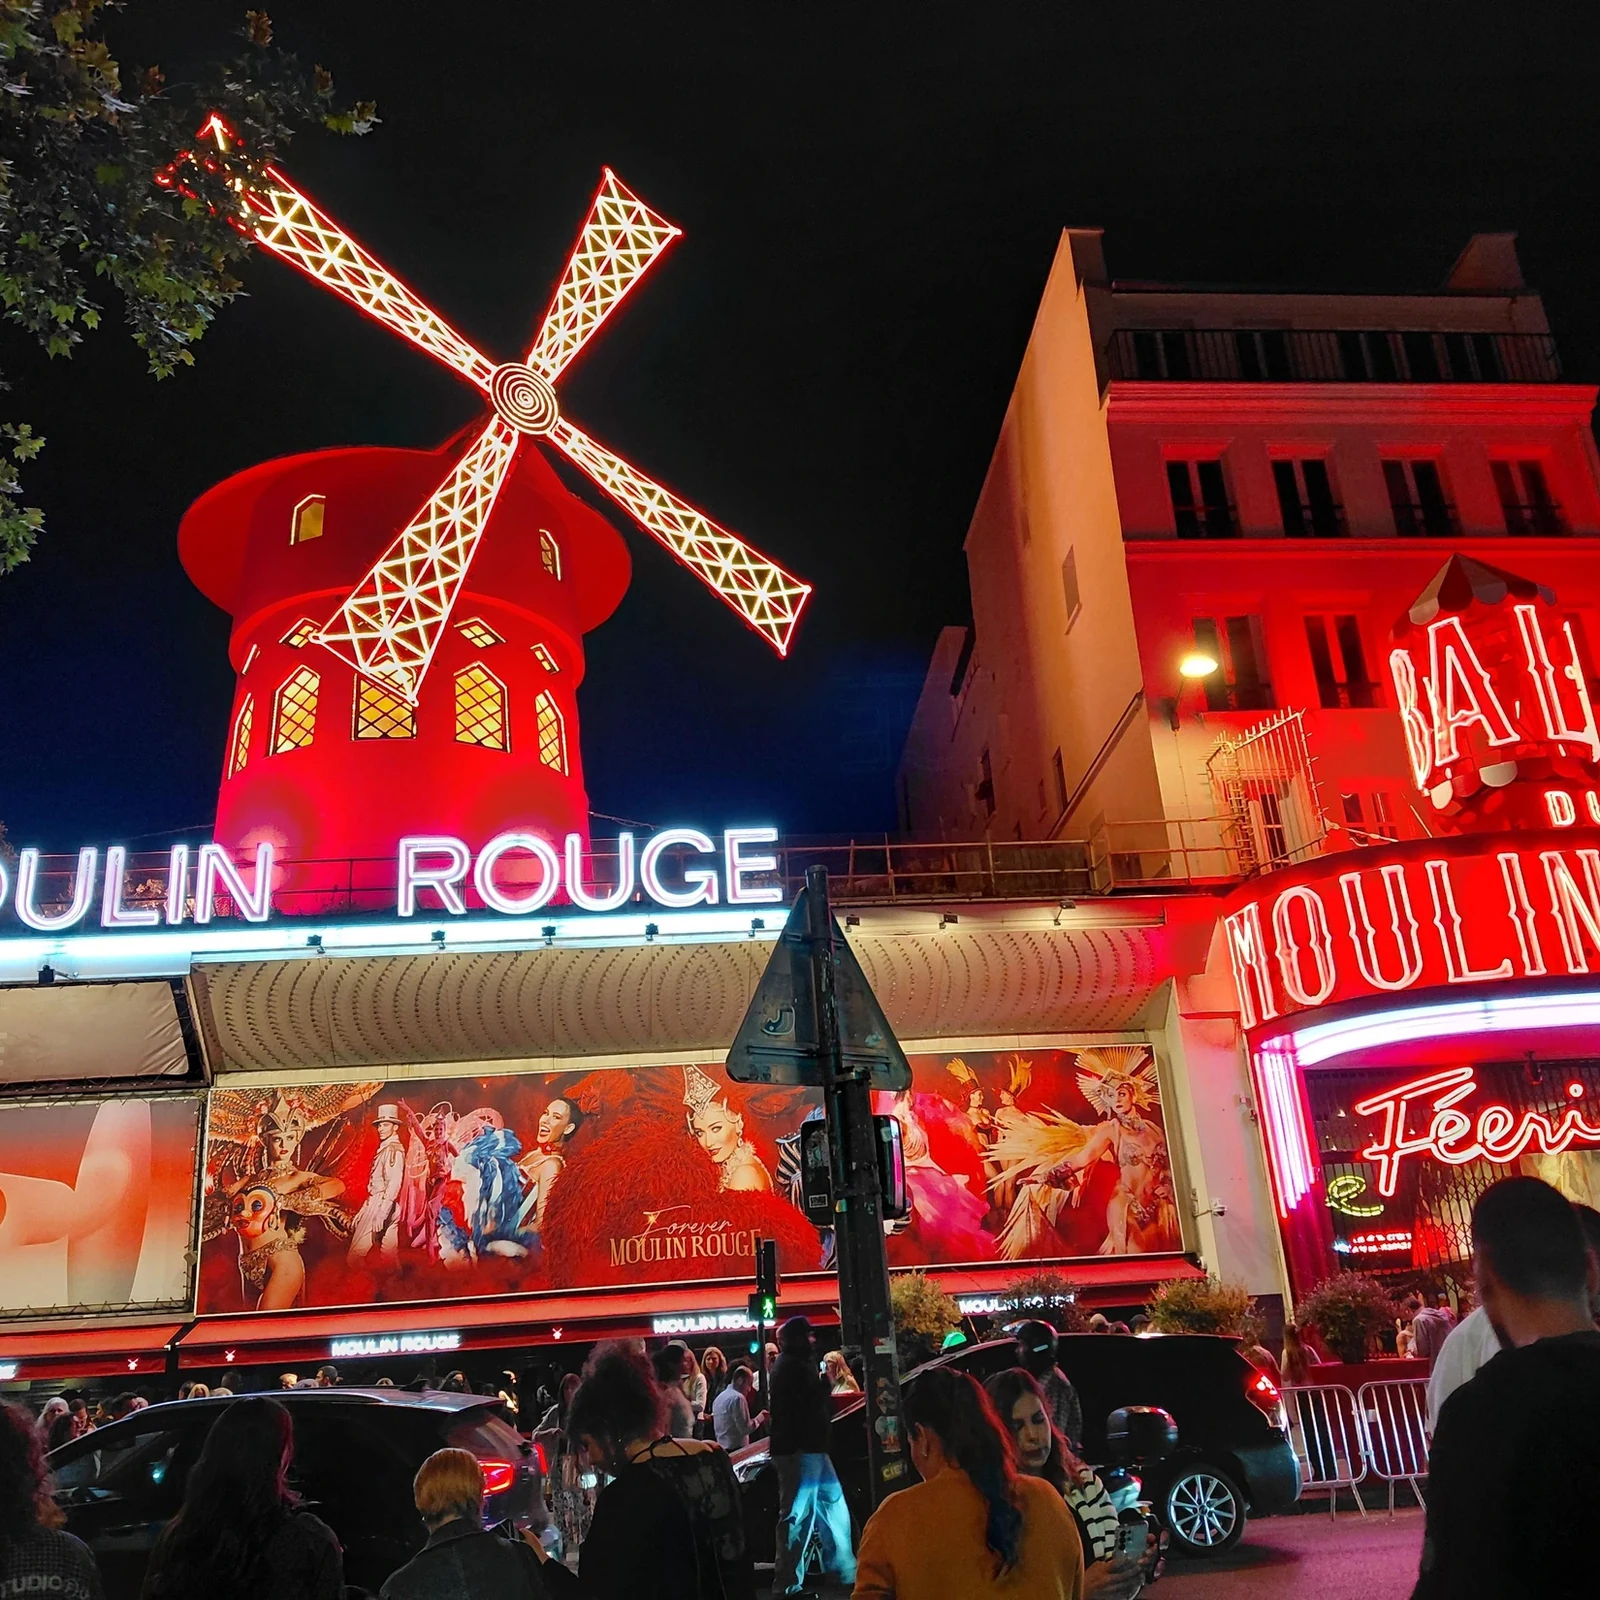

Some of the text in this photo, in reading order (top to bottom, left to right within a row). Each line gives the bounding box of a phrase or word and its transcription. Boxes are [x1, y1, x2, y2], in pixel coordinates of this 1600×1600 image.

[0, 827, 783, 932] ULIN ROUGE
[1224, 849, 1600, 1030] MOULIN
[632, 1204, 733, 1248] Forever
[610, 1236, 690, 1268] MOULIN
[653, 1316, 717, 1335] MOULIN
[331, 1333, 461, 1358] MOULIN ROUGE
